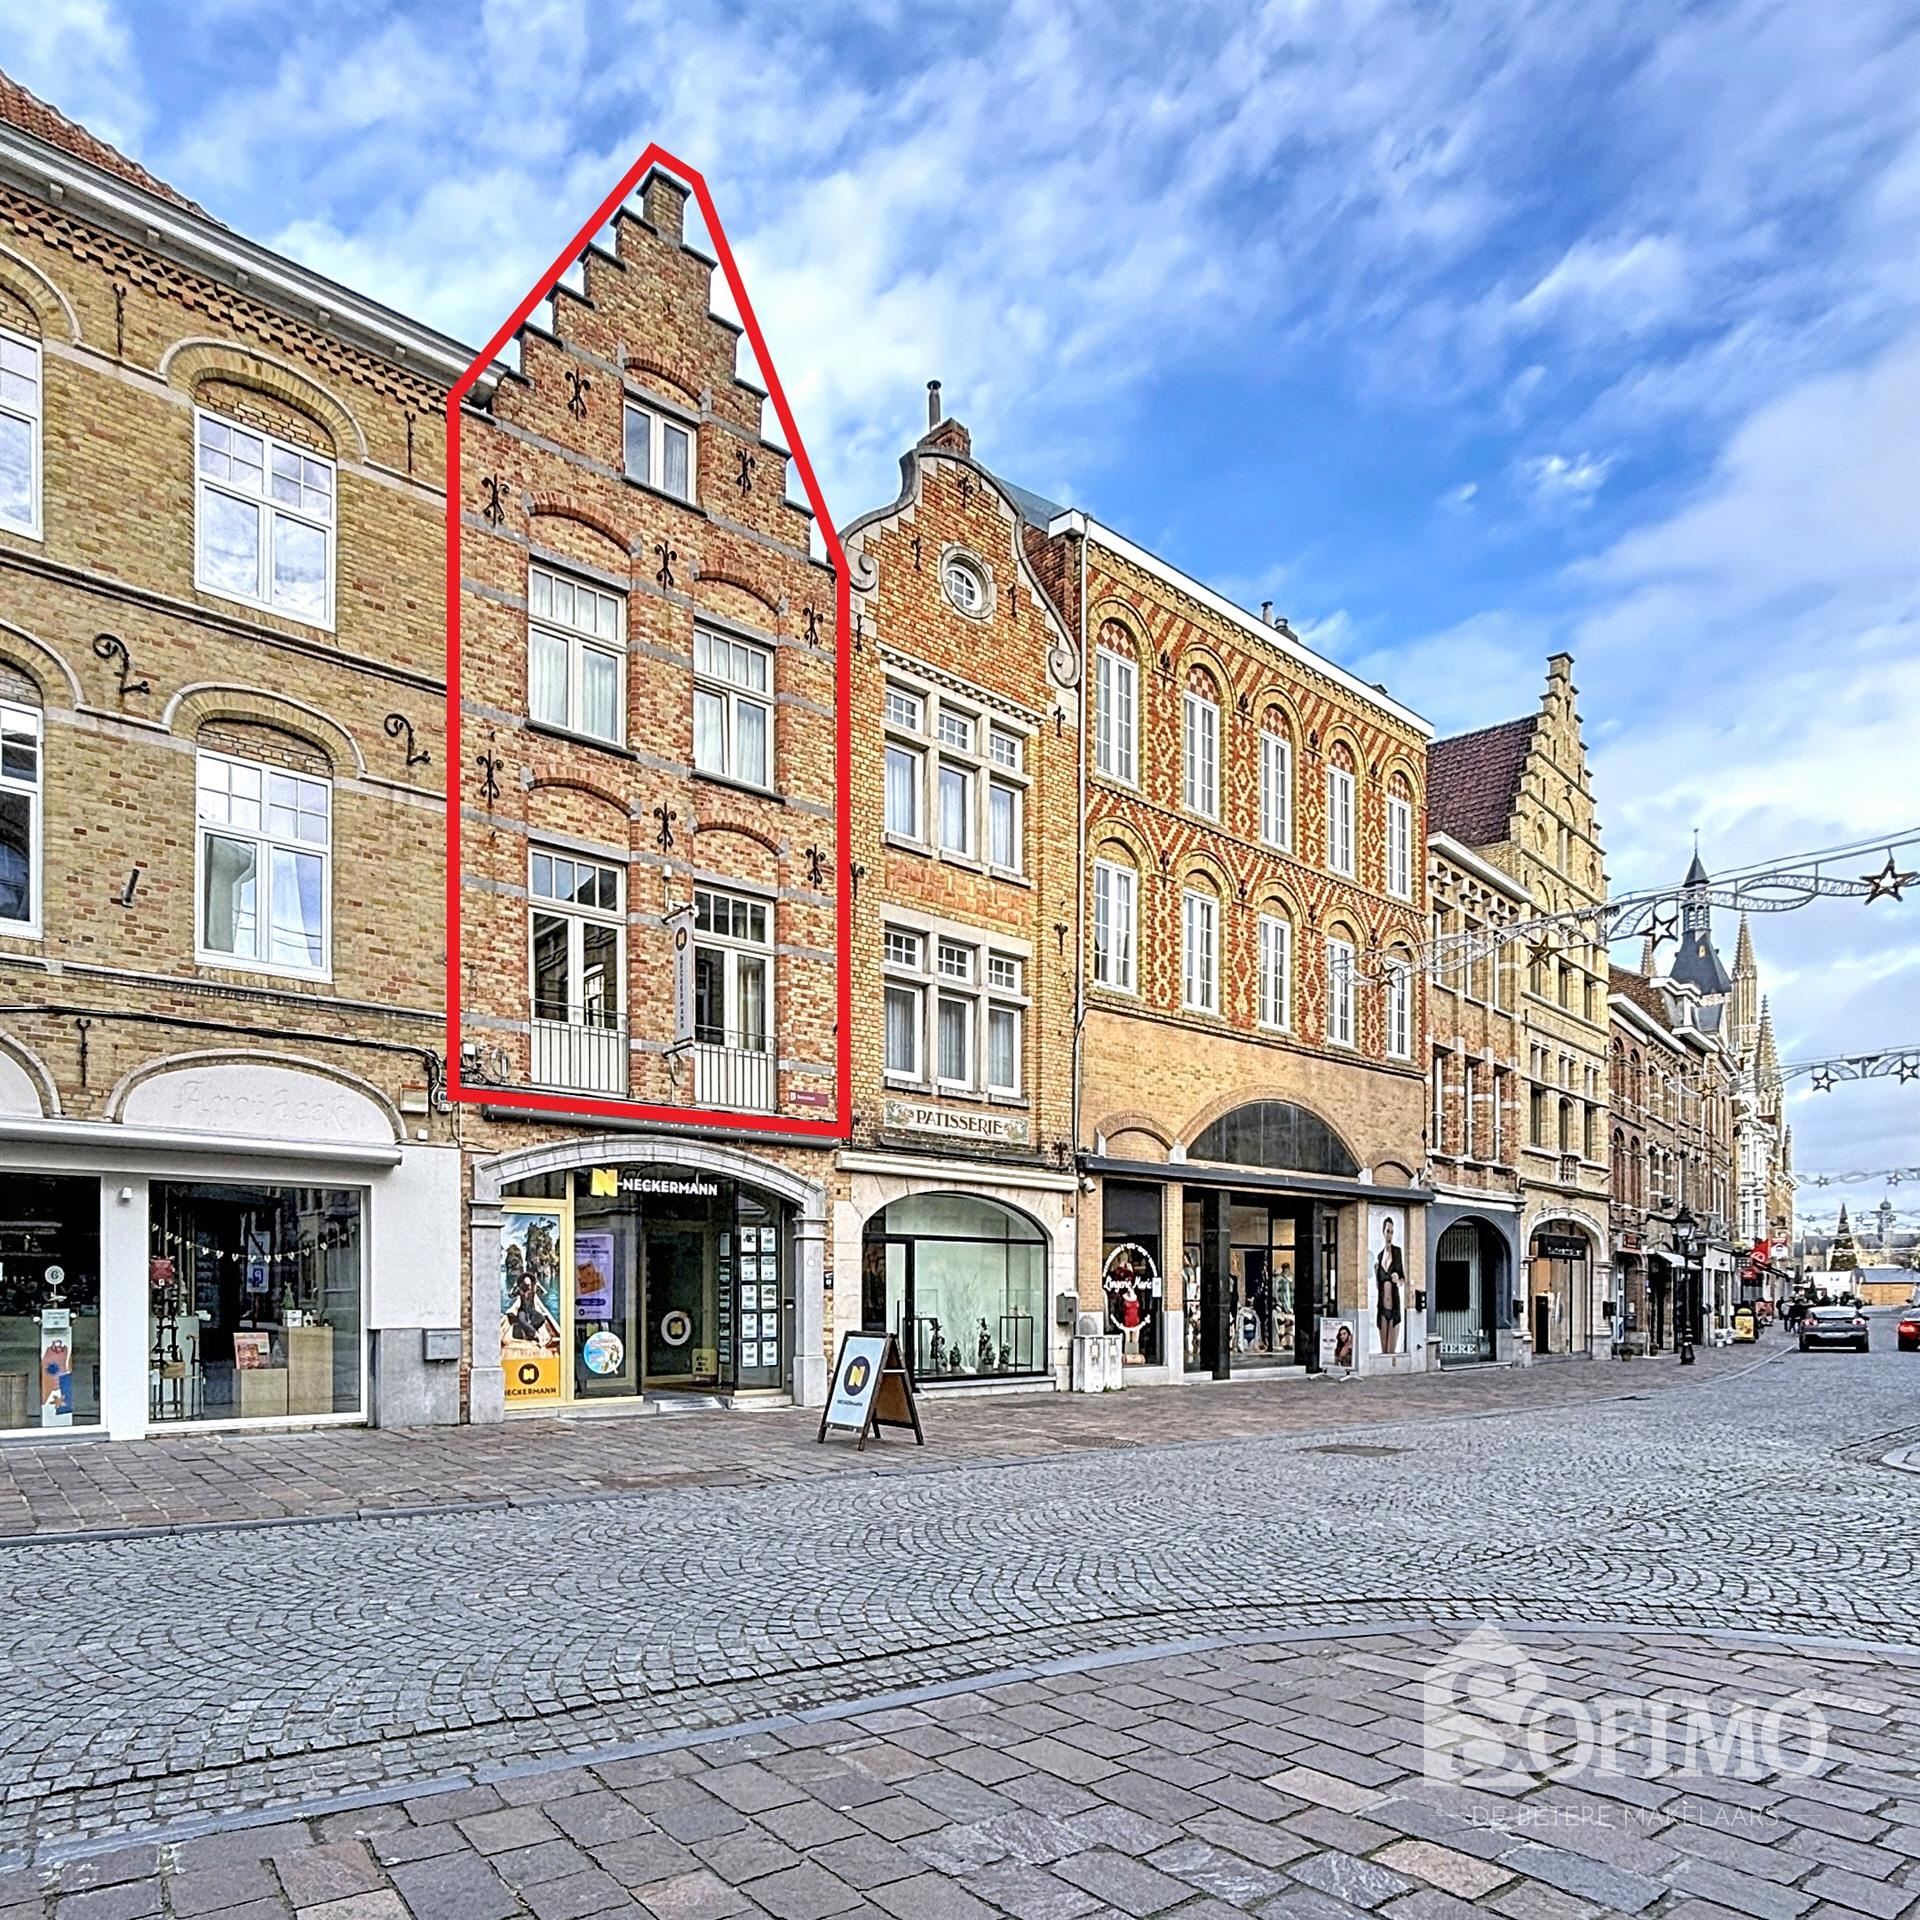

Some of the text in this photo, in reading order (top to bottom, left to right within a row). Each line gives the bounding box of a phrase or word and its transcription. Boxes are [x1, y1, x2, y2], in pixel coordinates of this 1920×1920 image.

[916, 1109, 1003, 1136] PATISSERIE
[590, 1167, 718, 1197] N NECKERMANN
[848, 1365, 866, 1387] N
